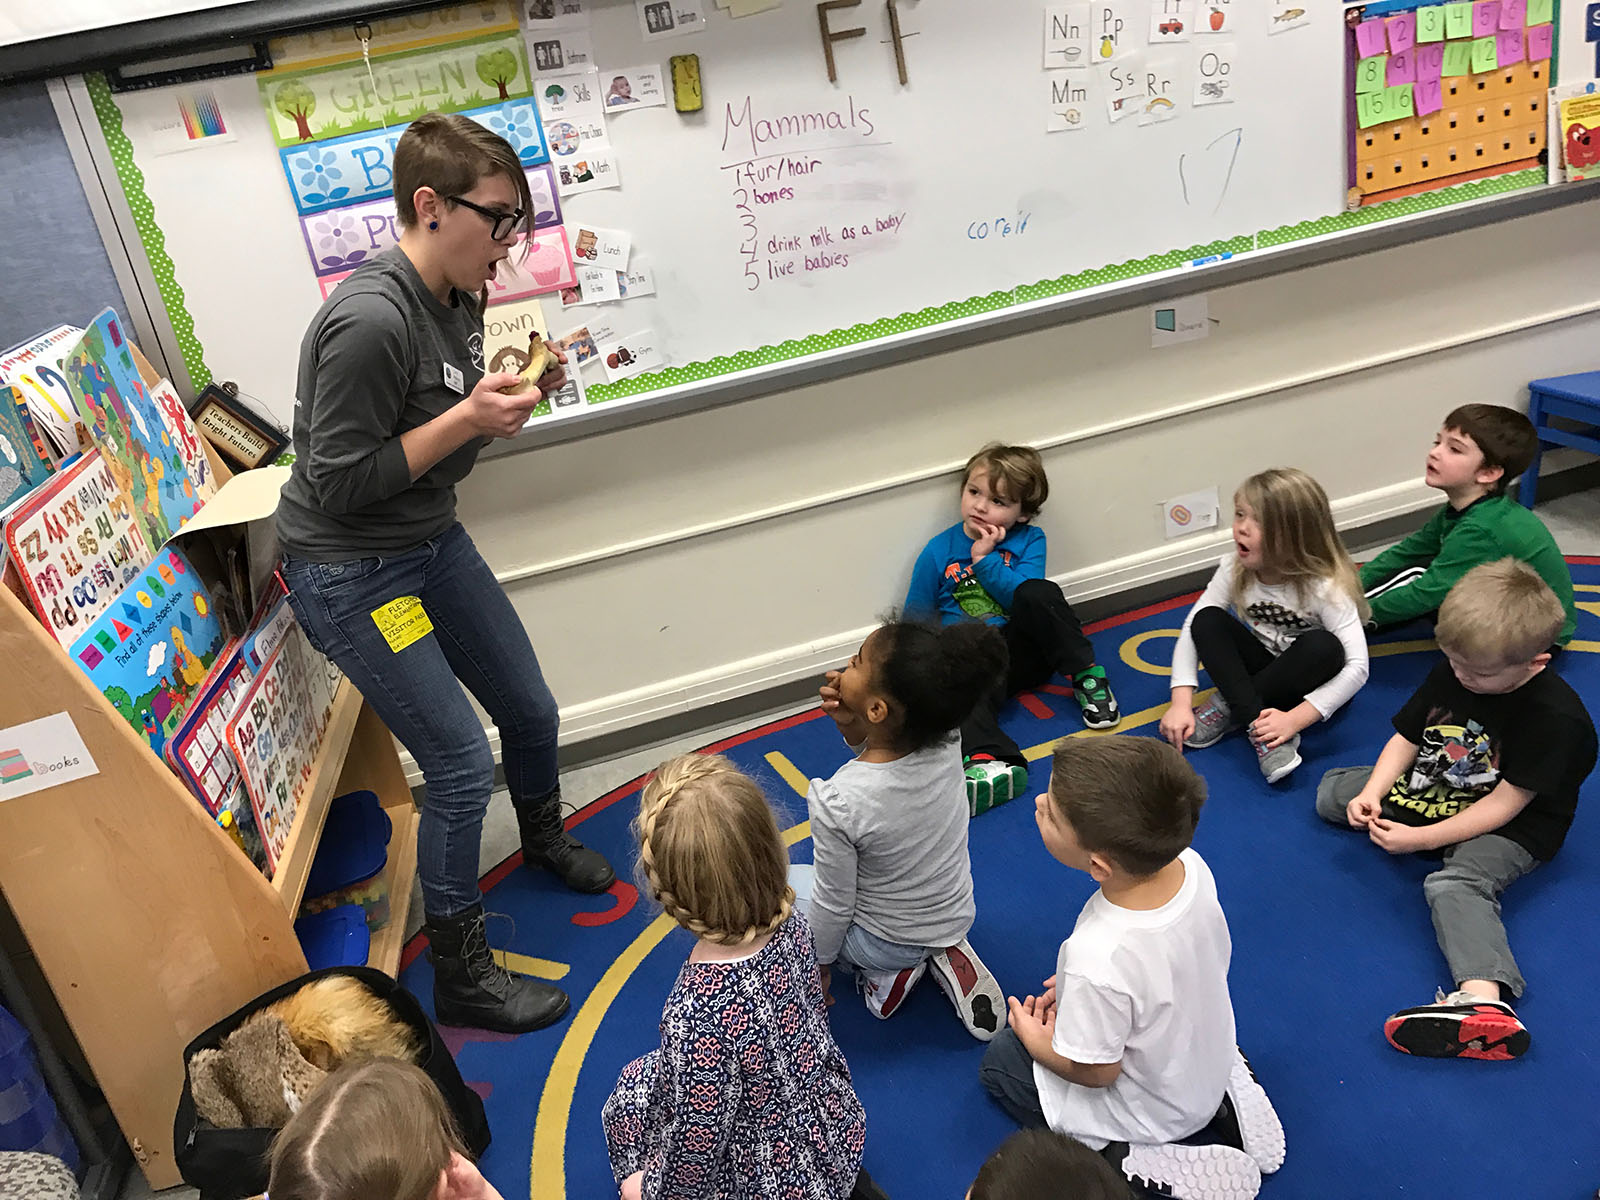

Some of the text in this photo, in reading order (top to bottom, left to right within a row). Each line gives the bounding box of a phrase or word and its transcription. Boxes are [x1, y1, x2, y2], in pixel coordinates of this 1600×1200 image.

[1052, 14, 1080, 40] Nn
[1103, 8, 1124, 46] Pp
[1425, 10, 1436, 32] 3
[1453, 6, 1464, 26] 4
[1480, 4, 1490, 26] 5
[1395, 20, 1407, 42] 2
[1200, 52, 1230, 77] Oo
[1365, 61, 1377, 82] 8
[1394, 56, 1408, 74] 9
[329, 59, 467, 113] GREEN
[1052, 79, 1087, 104] Mm
[1110, 67, 1135, 91] Ss
[1146, 73, 1172, 97] Rr
[1363, 92, 1384, 117] 15
[1391, 87, 1410, 110] 16
[1420, 80, 1438, 105] 17
[721, 95, 874, 156] Mammals
[592, 160, 611, 174] Math
[744, 155, 822, 185] fur/hair
[1179, 127, 1243, 217] 17
[733, 186, 794, 213] 2 bones
[739, 214, 757, 241] 3
[740, 212, 907, 262] 4 drink milk as a baby
[602, 243, 621, 256] Lunch
[744, 250, 849, 291] 5 live babies
[483, 313, 535, 339] own
[202, 417, 257, 460] Bright Futures
[208, 407, 266, 451] Teachers Build
[115, 648, 132, 669] Find
[128, 640, 139, 655] all
[135, 631, 146, 647] of
[142, 619, 159, 640] these
[154, 603, 172, 626] shapes
[386, 618, 415, 639] VISITOR
[32, 756, 80, 776] books
